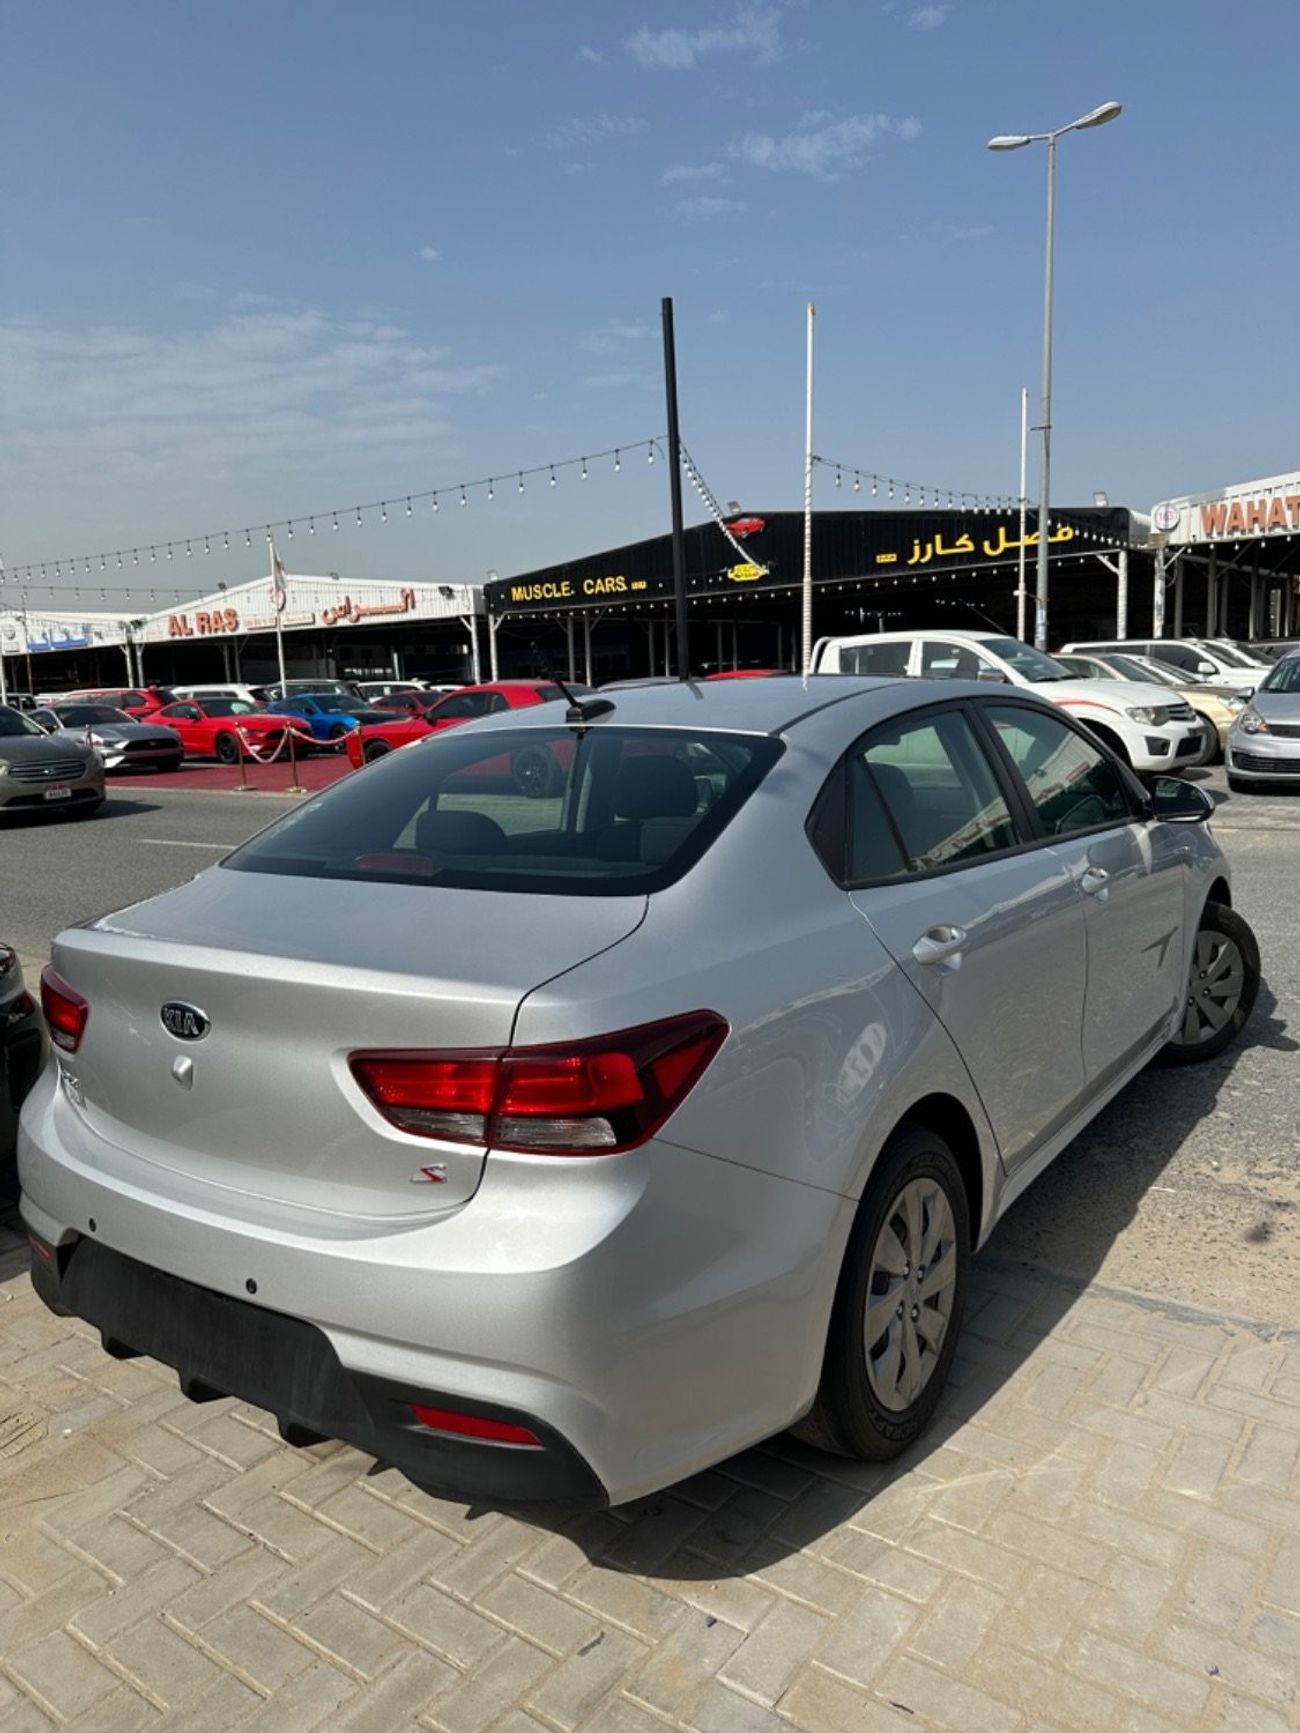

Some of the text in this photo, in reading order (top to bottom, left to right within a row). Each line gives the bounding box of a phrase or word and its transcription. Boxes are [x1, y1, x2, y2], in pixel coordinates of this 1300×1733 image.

[1200, 495, 1300, 538] WAHAT
[907, 533, 975, 564] كارز
[511, 581, 571, 601] MUSCLE
[583, 576, 627, 595] CARS
[168, 614, 193, 637] AL
[196, 608, 240, 635] RAS
[164, 1007, 200, 1036] KIA
[409, 1162, 448, 1185] S
